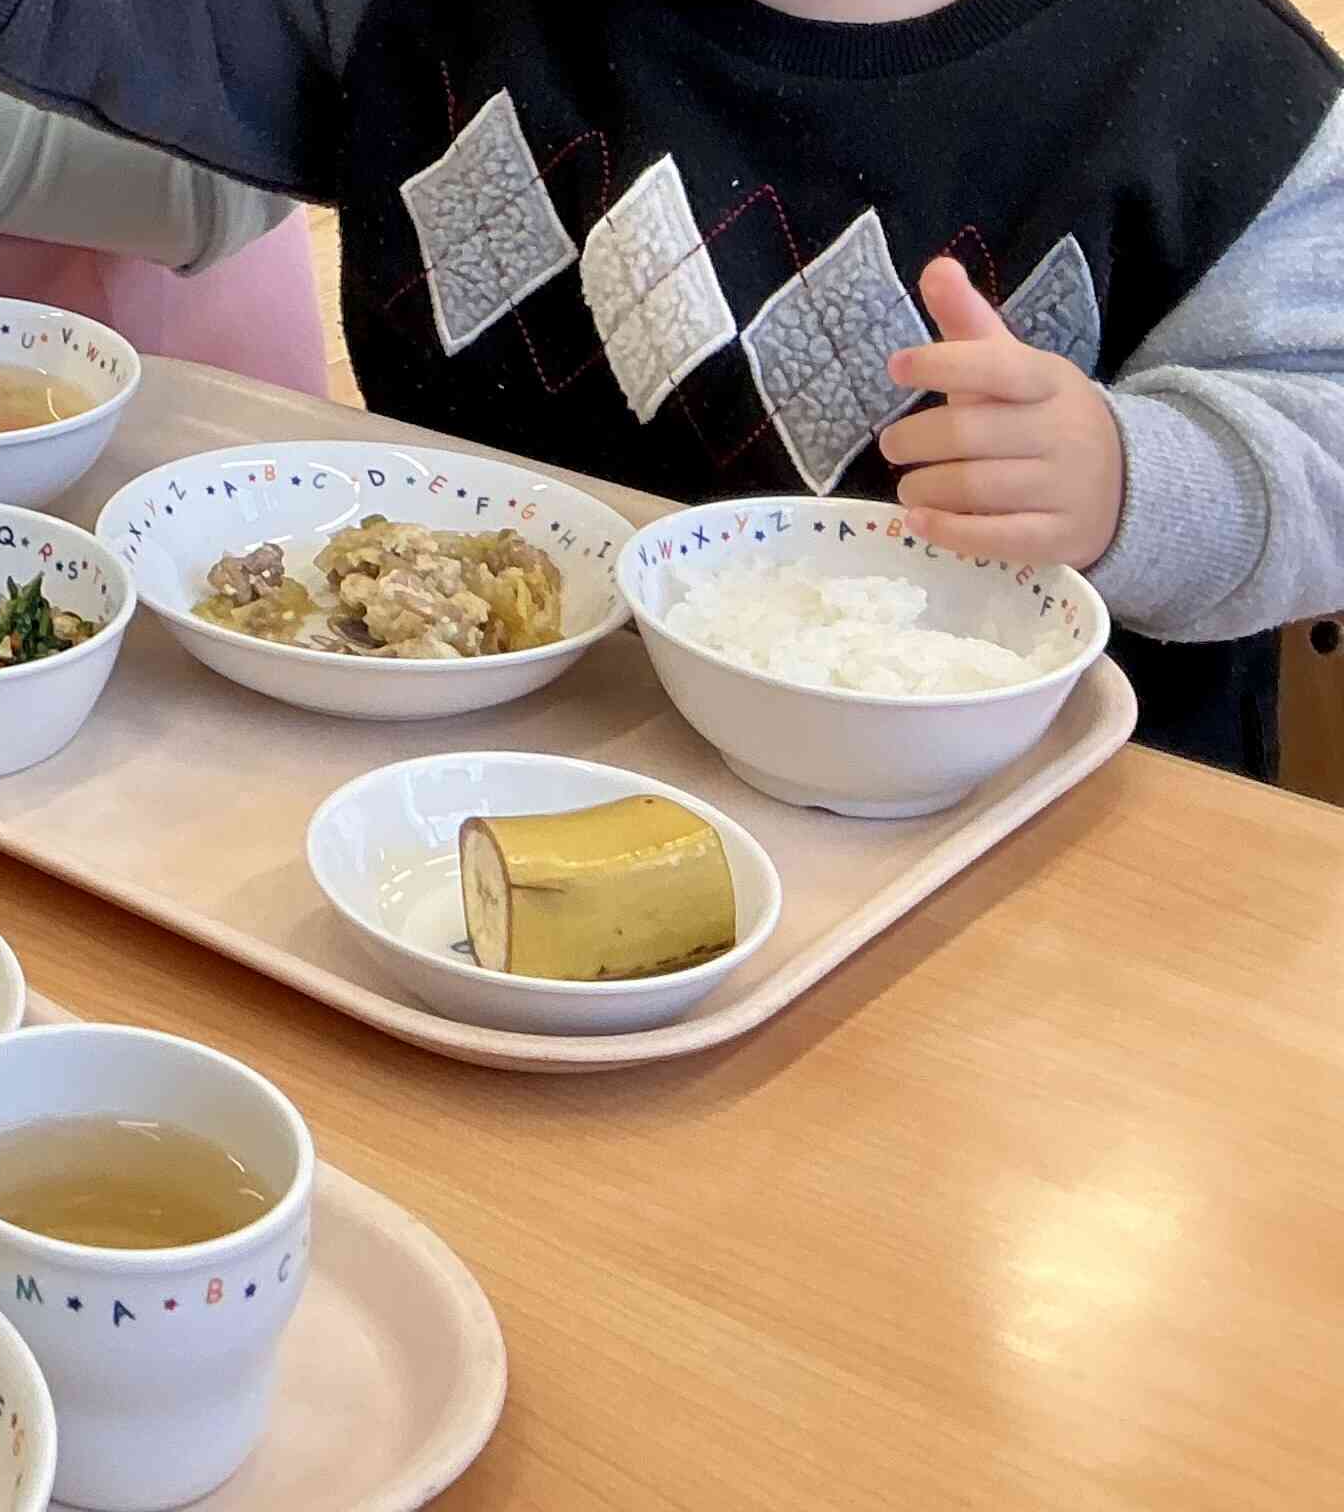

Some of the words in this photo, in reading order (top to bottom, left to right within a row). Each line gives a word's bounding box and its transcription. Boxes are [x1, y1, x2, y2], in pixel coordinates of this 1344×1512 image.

[21, 332, 34, 349] U
[129, 522, 142, 543] X
[169, 480, 187, 500] Z
[223, 480, 238, 499] A
[264, 464, 276, 481] B
[313, 473, 328, 490] C
[367, 469, 385, 487] D
[428, 475, 449, 494] E
[476, 497, 490, 515] F
[521, 503, 537, 520] G
[558, 529, 577, 550] H
[597, 540, 612, 559] I
[38, 543, 53, 563] R
[68, 561, 79, 580] S
[657, 538, 673, 560] W
[691, 525, 710, 549] X
[735, 512, 750, 534] Y
[769, 510, 791, 533] Z
[838, 520, 856, 541] A
[886, 518, 903, 537] B
[1016, 564, 1035, 586] E
[1040, 595, 1055, 617] F
[16, 1274, 44, 1304] M
[112, 1300, 136, 1327] A
[207, 1277, 223, 1305] B
